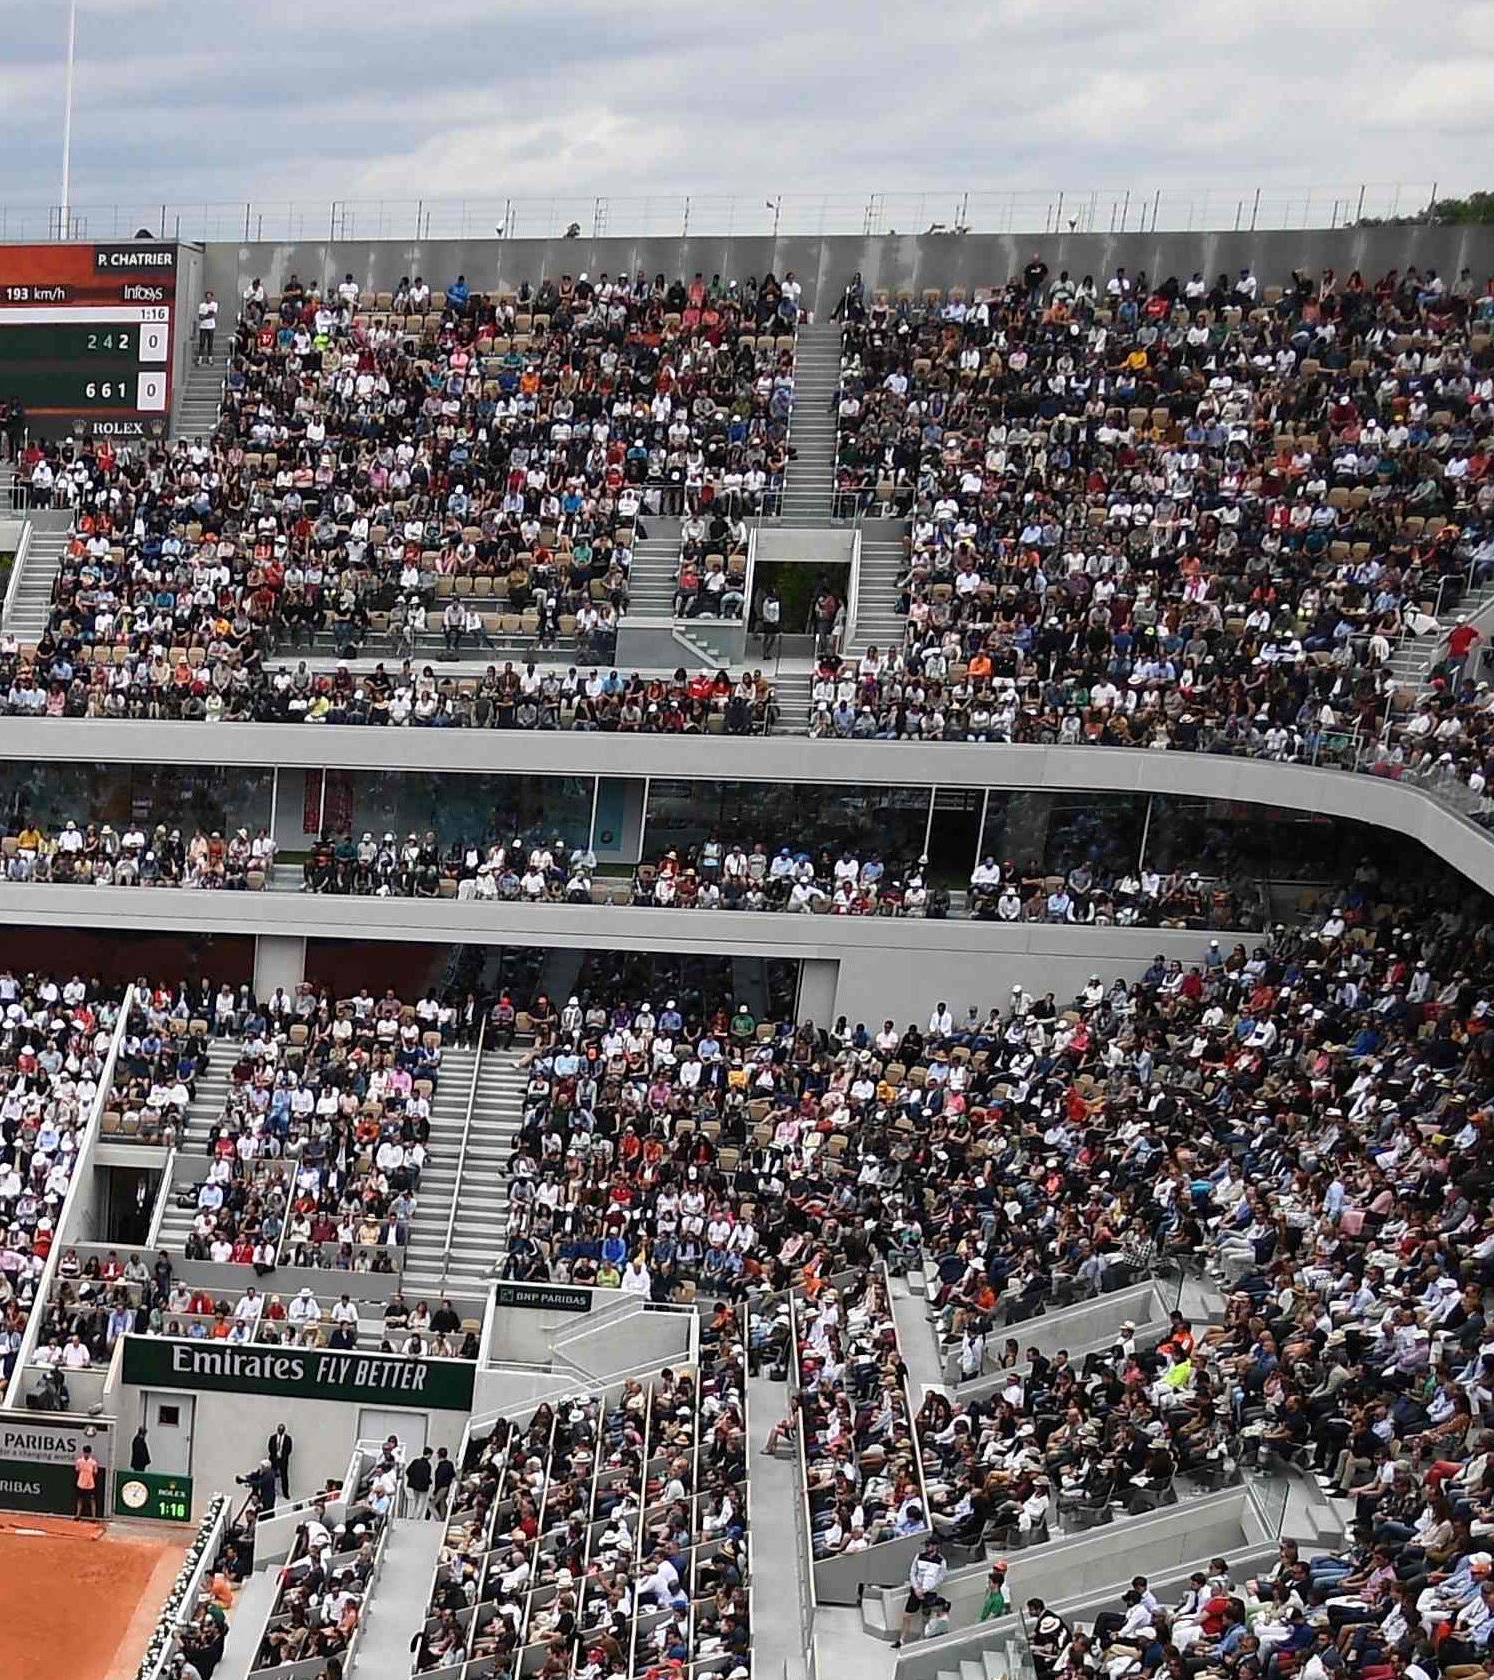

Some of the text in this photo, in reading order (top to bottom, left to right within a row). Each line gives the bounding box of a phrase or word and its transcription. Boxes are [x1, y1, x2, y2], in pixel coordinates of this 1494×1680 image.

[98, 253, 172, 266] P. CHATRIER
[6, 288, 29, 301] 193
[34, 286, 65, 300] km/h
[125, 285, 163, 302] Infosys
[141, 308, 165, 320] 1:16
[88, 334, 158, 349] 2 4 2 0
[86, 382, 156, 397] 6 6 1 0
[93, 423, 143, 434] ROLEX
[516, 1291, 586, 1305] BNP PARIBAS
[172, 1346, 428, 1391] Emirates FLY BETTER
[5, 1432, 76, 1453] PARIBAS
[159, 1502, 185, 1517] 1:16
